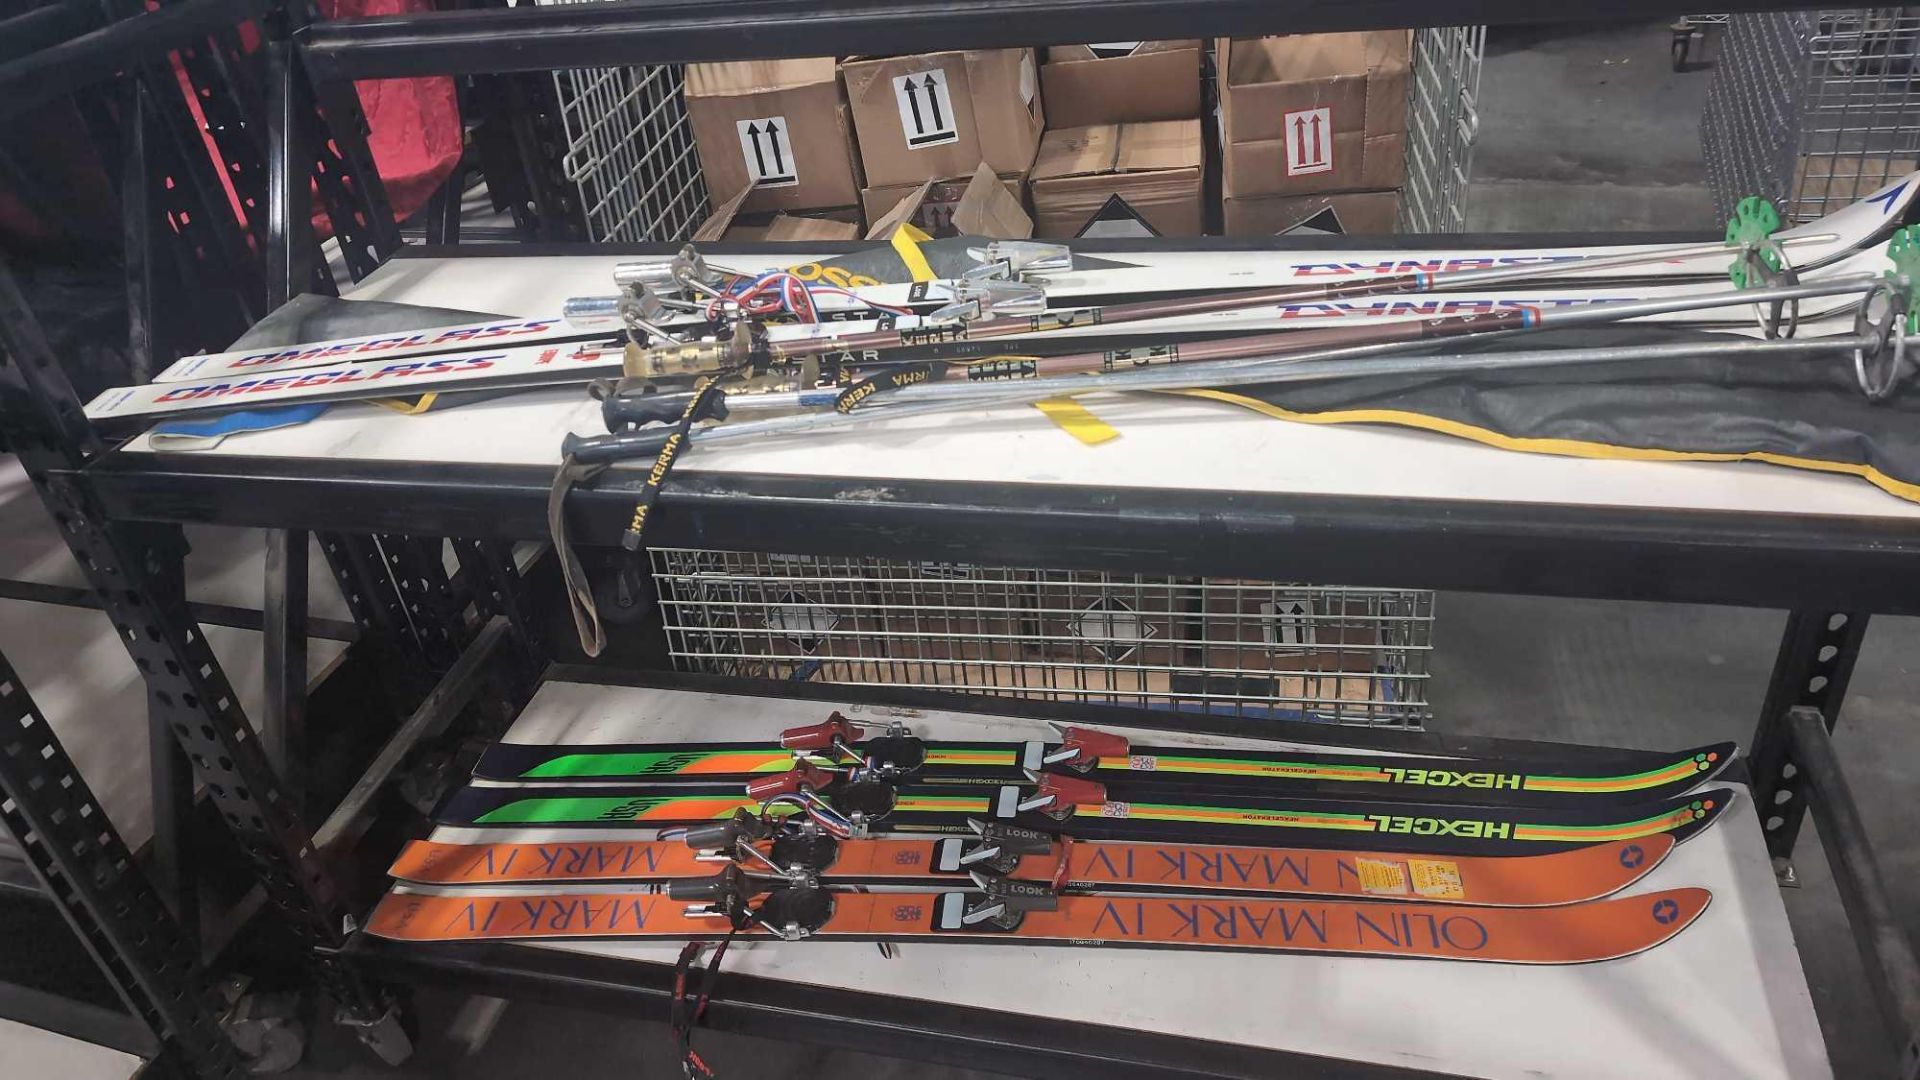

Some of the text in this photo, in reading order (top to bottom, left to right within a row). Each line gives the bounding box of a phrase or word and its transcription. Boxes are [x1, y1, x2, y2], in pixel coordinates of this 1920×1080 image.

[227, 319, 561, 369] OMEGLASS
[152, 354, 507, 404] OMEGLASS
[647, 433, 682, 486] KERMA
[629, 504, 648, 534] MA
[1383, 767, 1521, 791] HEXCEL
[1006, 828, 1039, 840] LOOK
[1368, 814, 1510, 840] HEXCEL
[464, 845, 669, 876] MARK IV
[1083, 847, 1134, 879] IV
[1157, 850, 1309, 887] MARK
[1010, 884, 1044, 896] LOOK
[444, 898, 657, 932] MARK IV
[1092, 901, 1489, 950] OLIN MARK IV
